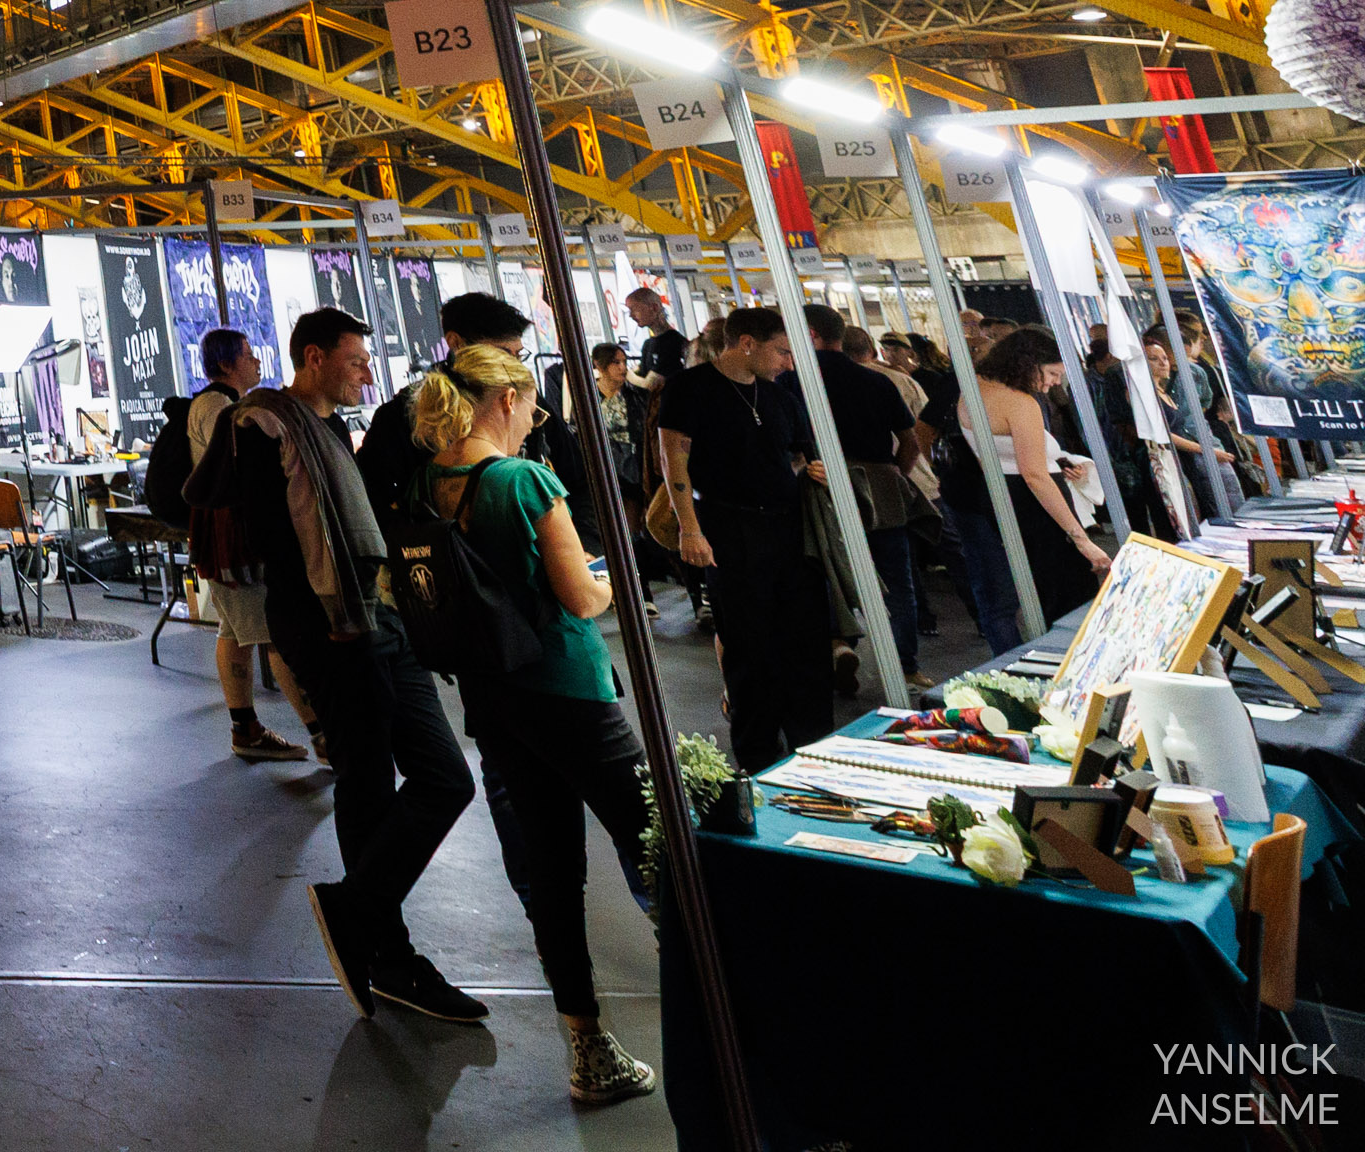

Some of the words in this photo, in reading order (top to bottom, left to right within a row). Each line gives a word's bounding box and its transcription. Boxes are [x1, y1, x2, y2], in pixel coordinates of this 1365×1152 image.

[413, 25, 472, 54] B23
[657, 100, 706, 124] B24
[834, 141, 876, 157] B25
[956, 172, 995, 187] B26
[222, 194, 245, 206] B33
[372, 212, 394, 224] B34
[1104, 212, 1123, 225] 28
[499, 225, 520, 236] B35
[599, 233, 619, 244] B36
[198, 298, 245, 310] BAEL
[123, 327, 160, 367] JOHN
[132, 359, 157, 384] MAXX
[120, 399, 145, 415] RADICAL
[1293, 399, 1345, 418] LIU
[1319, 420, 1344, 429] Scan
[1345, 421, 1358, 429] to
[401, 545, 431, 560] WEDNESDAY
